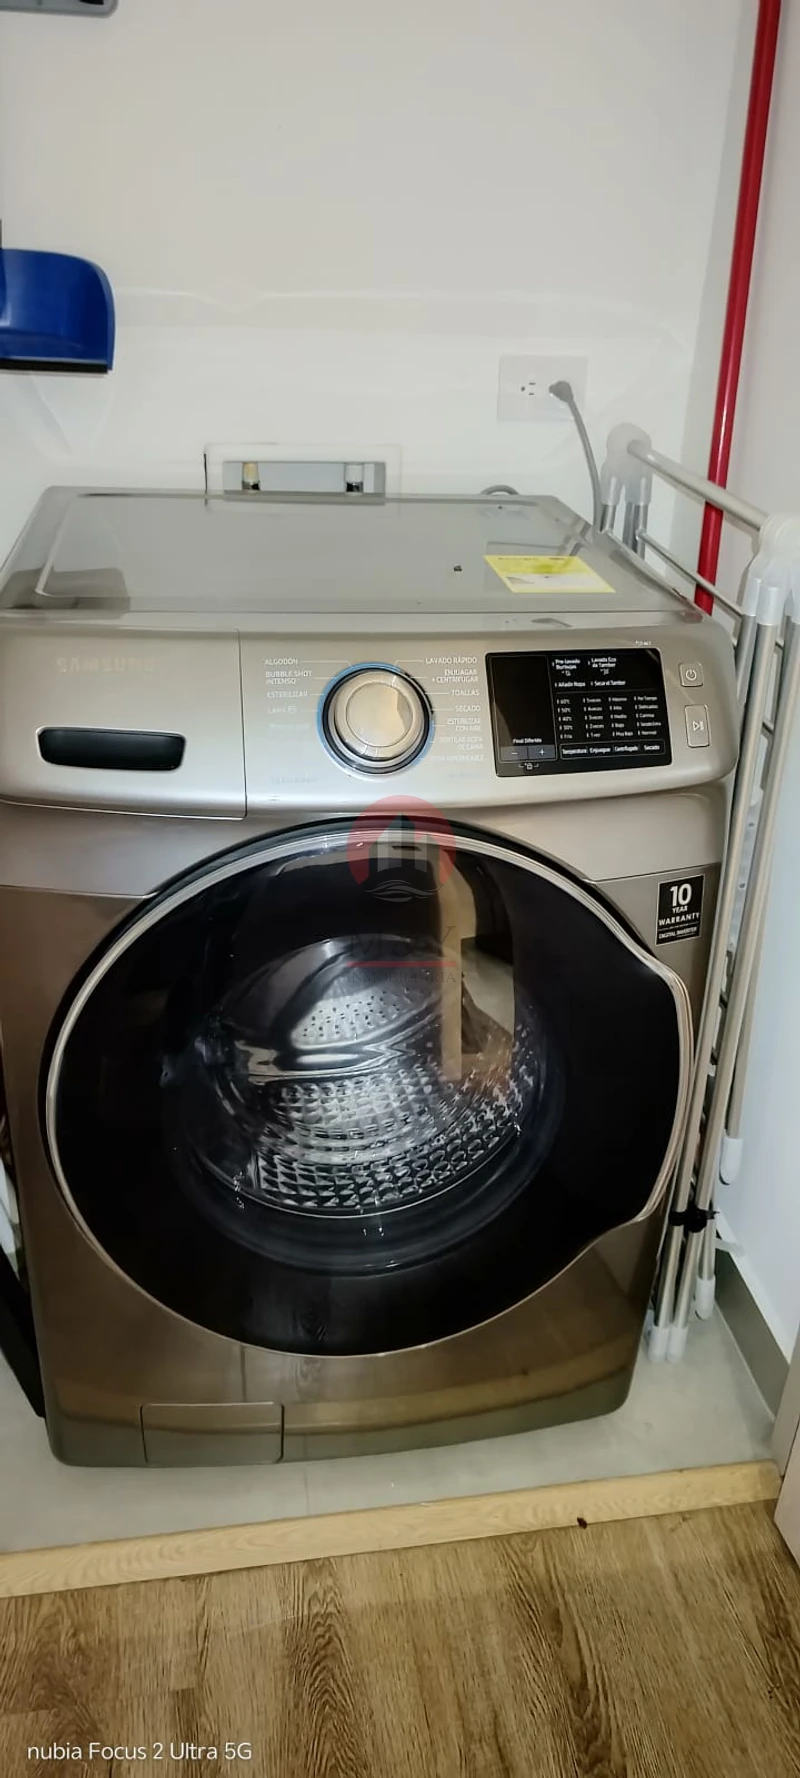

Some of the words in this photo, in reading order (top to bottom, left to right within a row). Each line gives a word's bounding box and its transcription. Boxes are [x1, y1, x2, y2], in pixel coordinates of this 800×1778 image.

[425, 657, 453, 665] LAVADO
[436, 676, 478, 684] CENTRIFUGAR
[670, 883, 692, 907] 10
[672, 905, 688, 914] YEAR
[659, 912, 699, 926] WARRANTY
